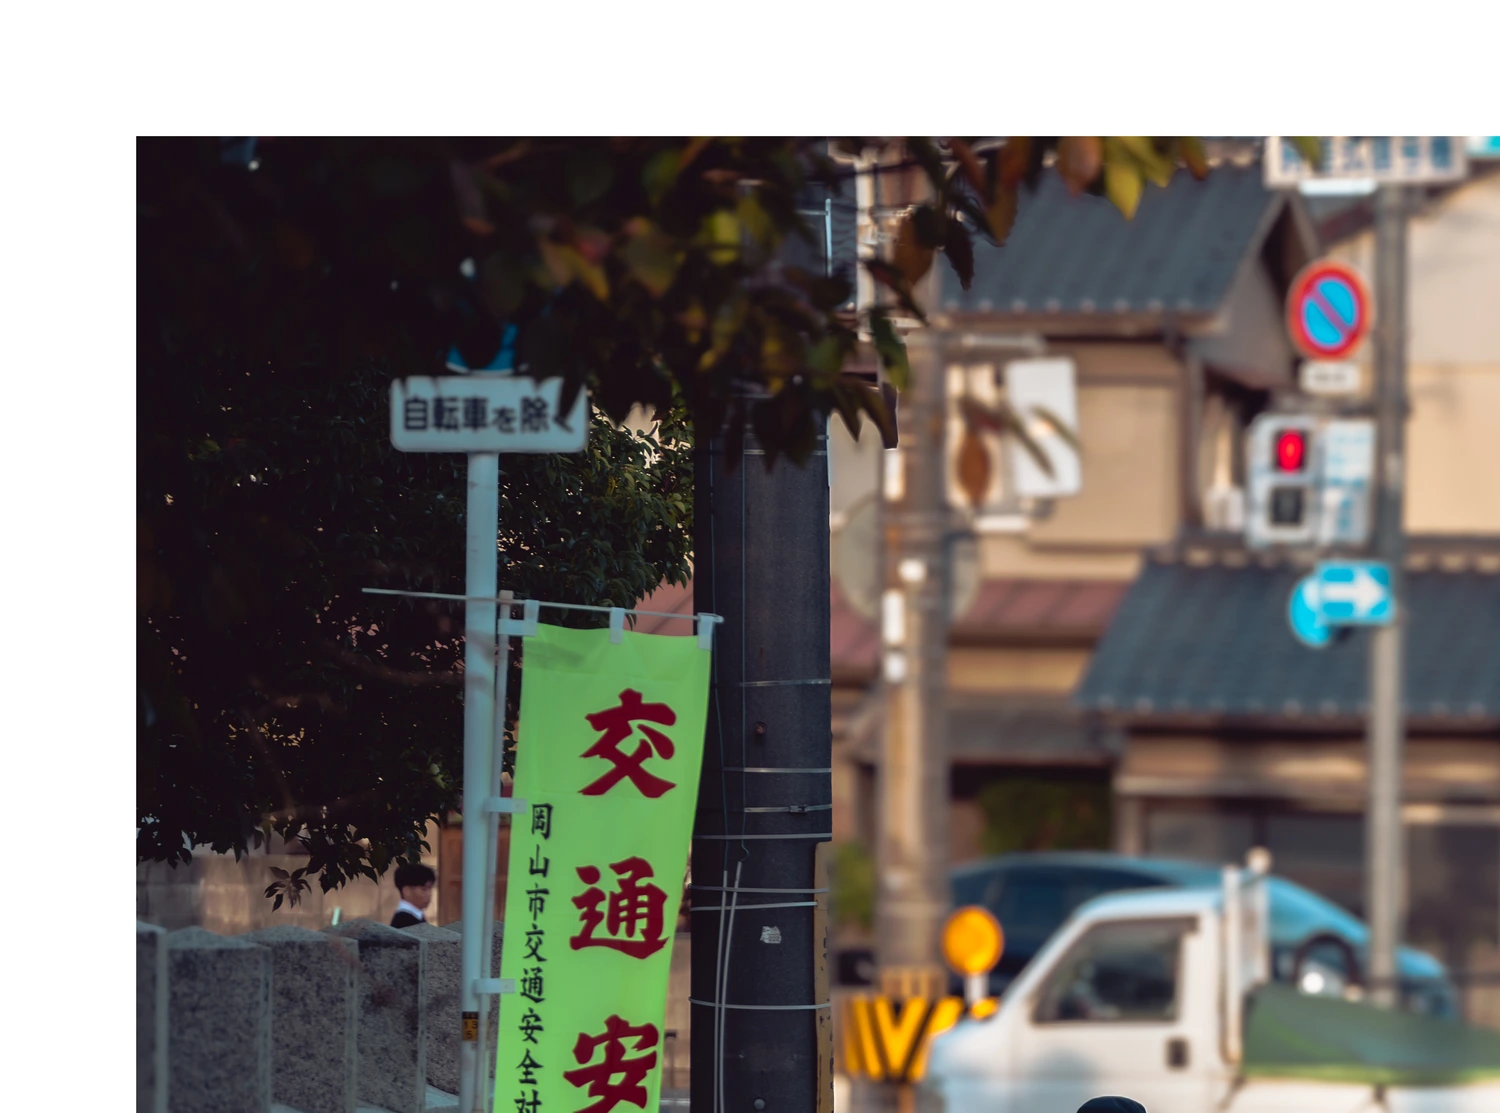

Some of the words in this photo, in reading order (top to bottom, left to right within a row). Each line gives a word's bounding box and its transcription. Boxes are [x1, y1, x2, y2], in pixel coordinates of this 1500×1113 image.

[404, 395, 573, 434] 自転車を除く
